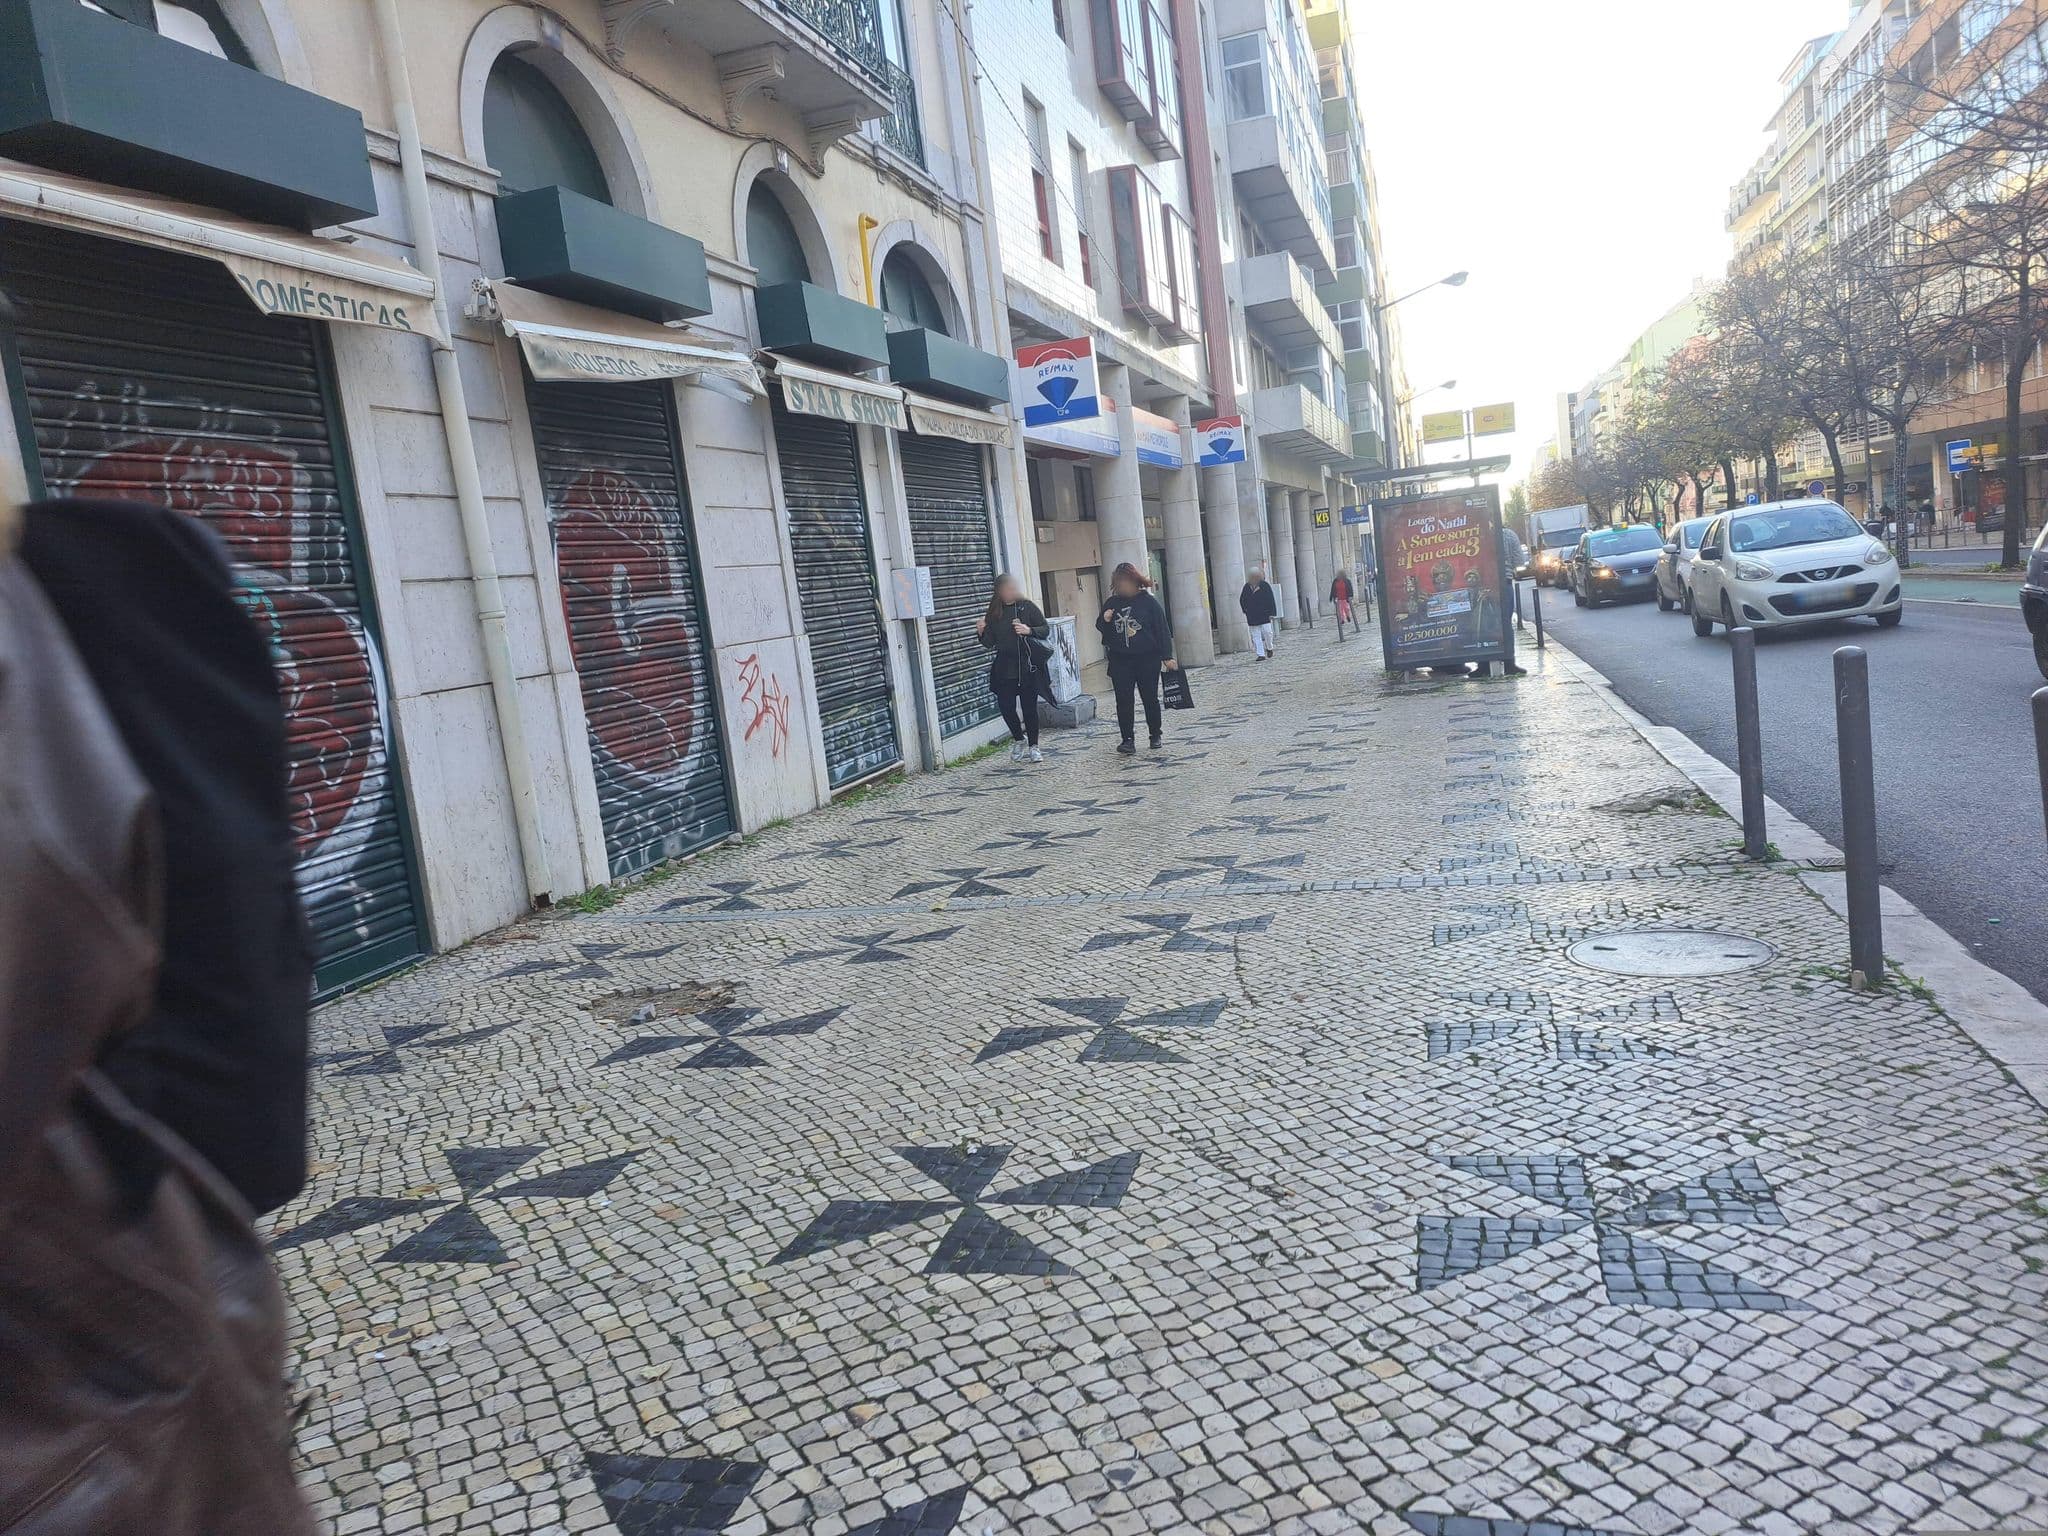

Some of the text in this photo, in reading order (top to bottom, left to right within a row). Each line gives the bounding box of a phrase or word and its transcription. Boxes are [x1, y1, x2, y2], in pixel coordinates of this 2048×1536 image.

[1038, 364, 1074, 378] RE/MAX
[790, 381, 901, 427] STAR SHOW
[1421, 515, 1467, 534] do Natal
[1397, 524, 1480, 552] A Sorte sorri
[1436, 543, 1466, 558] cada
[1466, 537, 1480, 557] 3
